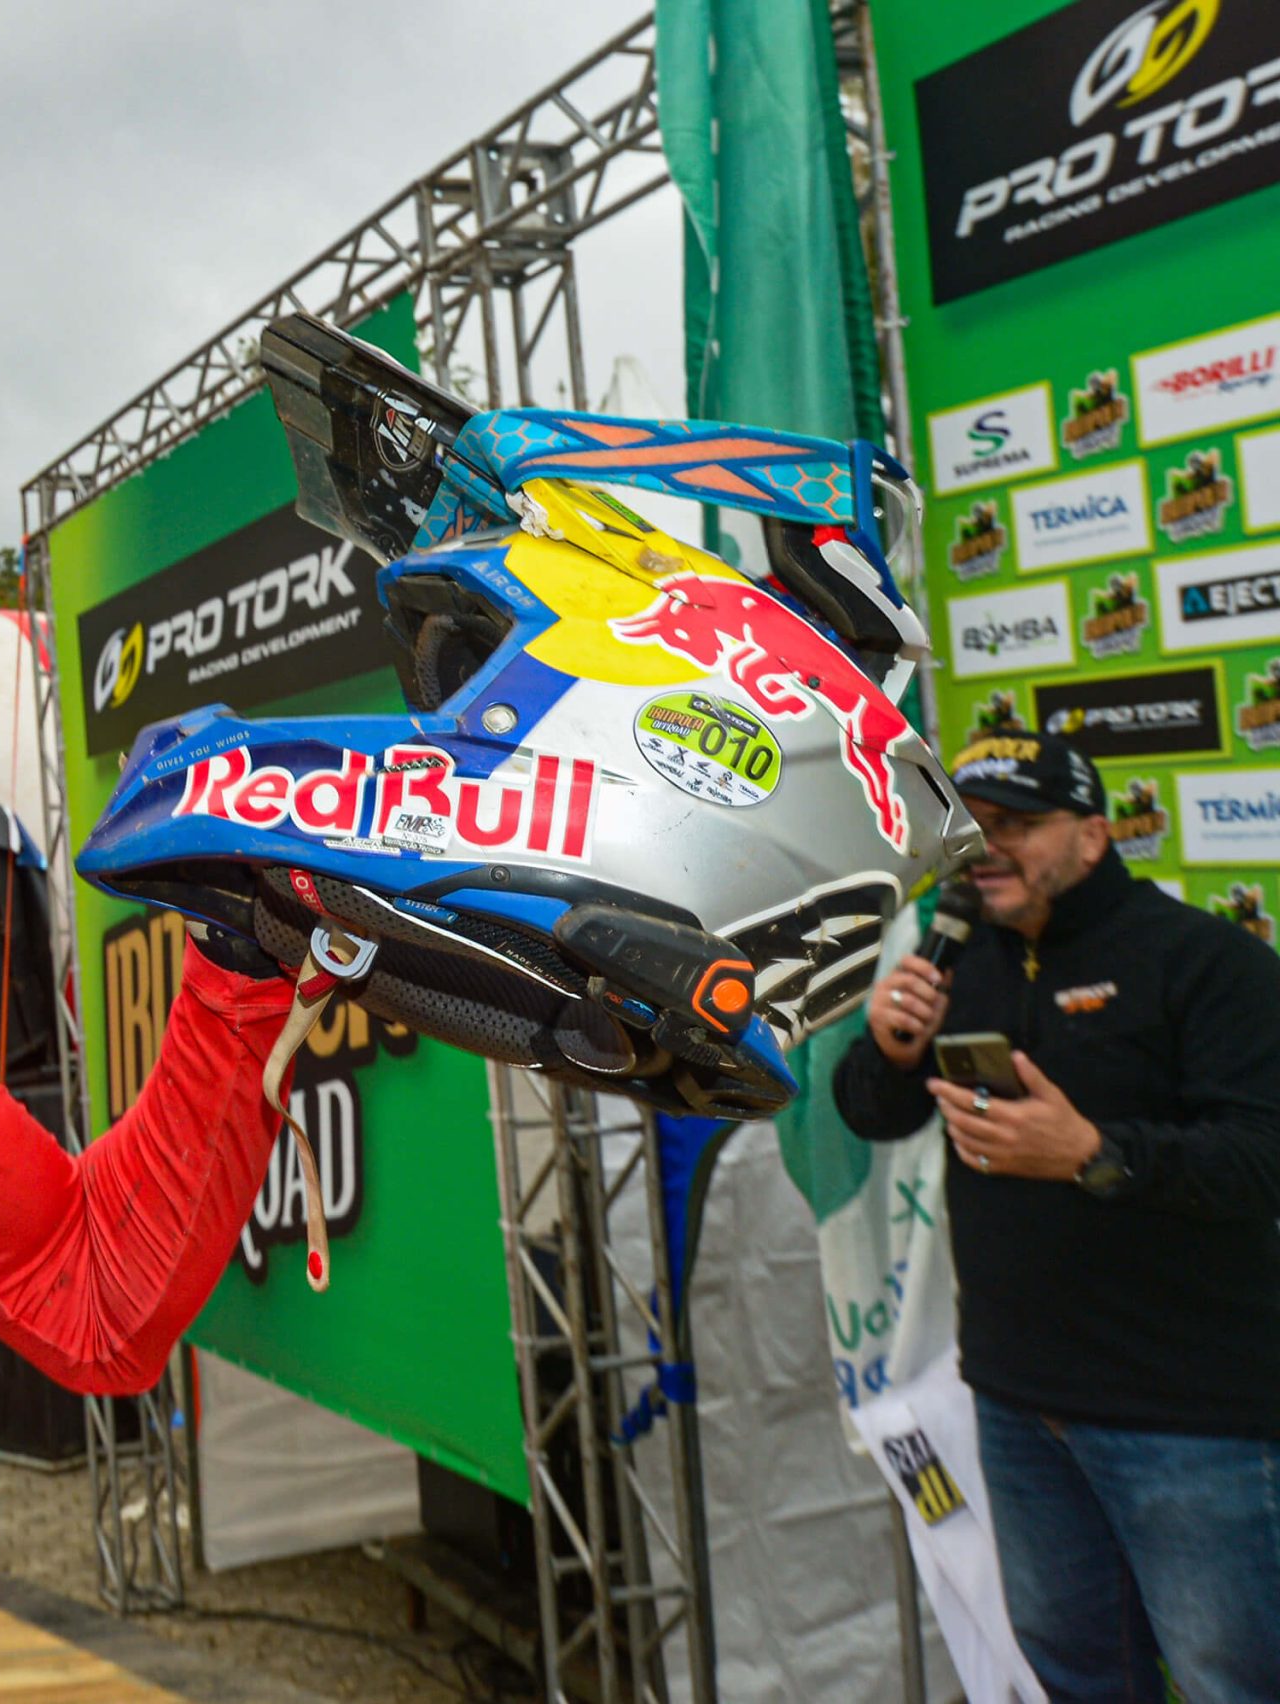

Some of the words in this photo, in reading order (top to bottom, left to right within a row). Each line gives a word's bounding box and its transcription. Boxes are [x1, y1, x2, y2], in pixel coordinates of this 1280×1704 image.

[956, 133, 1116, 238] PRO
[1004, 195, 1101, 243] RACING
[146, 597, 223, 674] PRO
[228, 540, 356, 638] TORK
[188, 654, 239, 684] RACING
[241, 607, 362, 665] DEVELOPMENT
[156, 756, 184, 771] GIVES
[189, 744, 210, 759] YOU
[215, 730, 251, 749] WINGS
[699, 721, 774, 781] 010
[173, 746, 371, 831] Red
[376, 749, 595, 858] Bull
